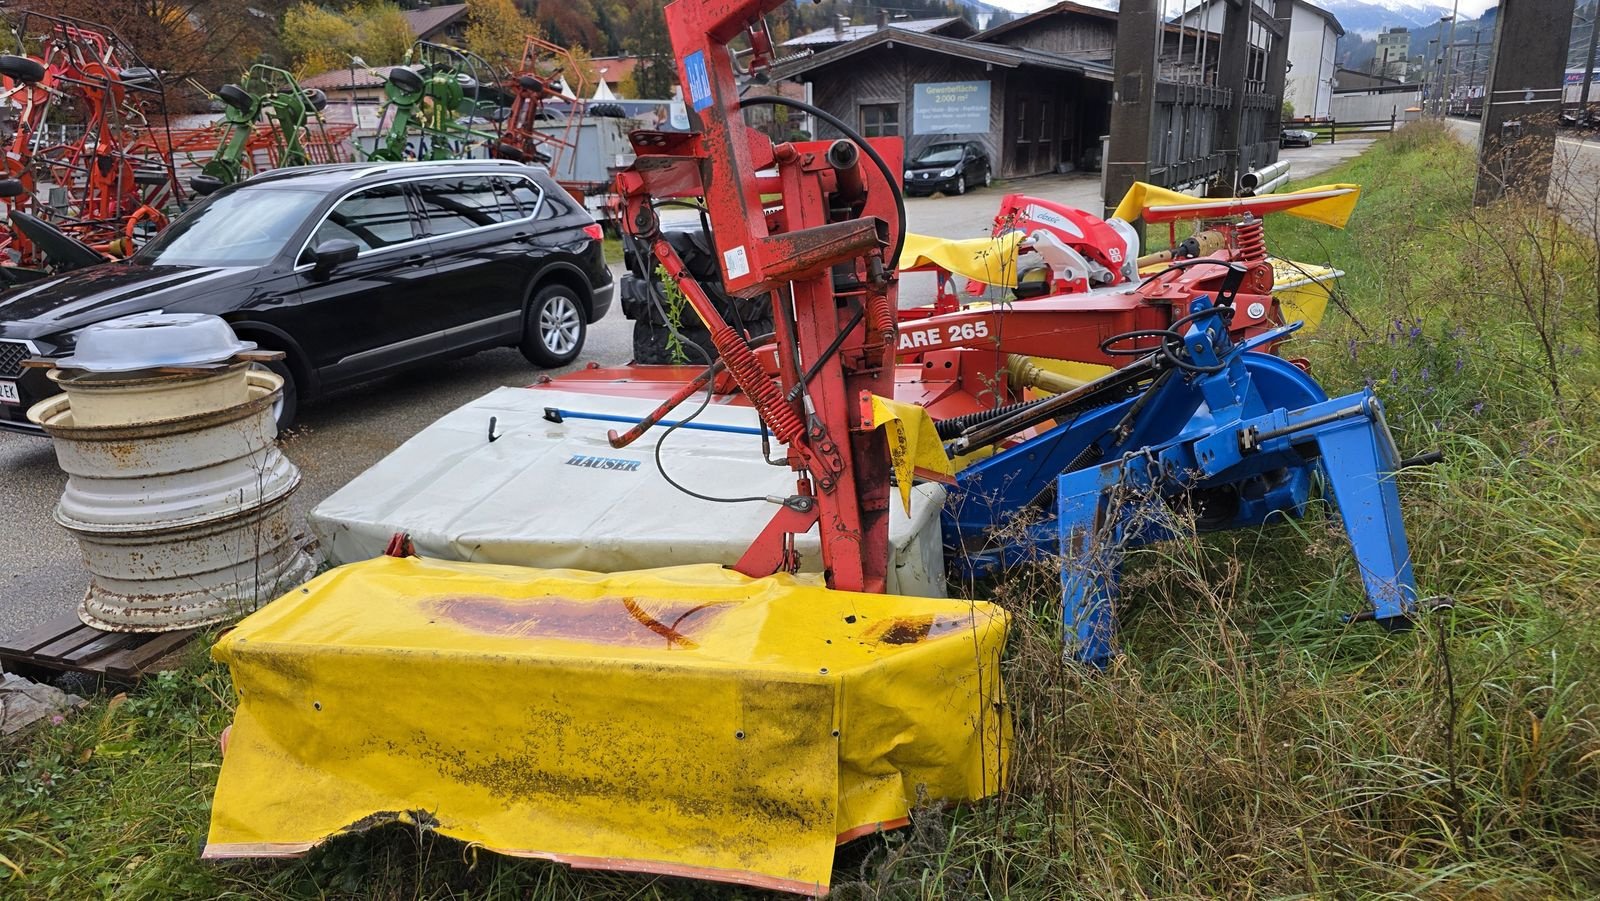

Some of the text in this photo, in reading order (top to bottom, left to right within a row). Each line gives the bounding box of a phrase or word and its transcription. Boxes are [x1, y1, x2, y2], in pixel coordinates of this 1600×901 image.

[926, 85, 978, 94] Gewerbefläche
[936, 94, 956, 103] 2.000
[897, 321, 988, 350] ARE 265
[565, 455, 641, 471] HAUSER
